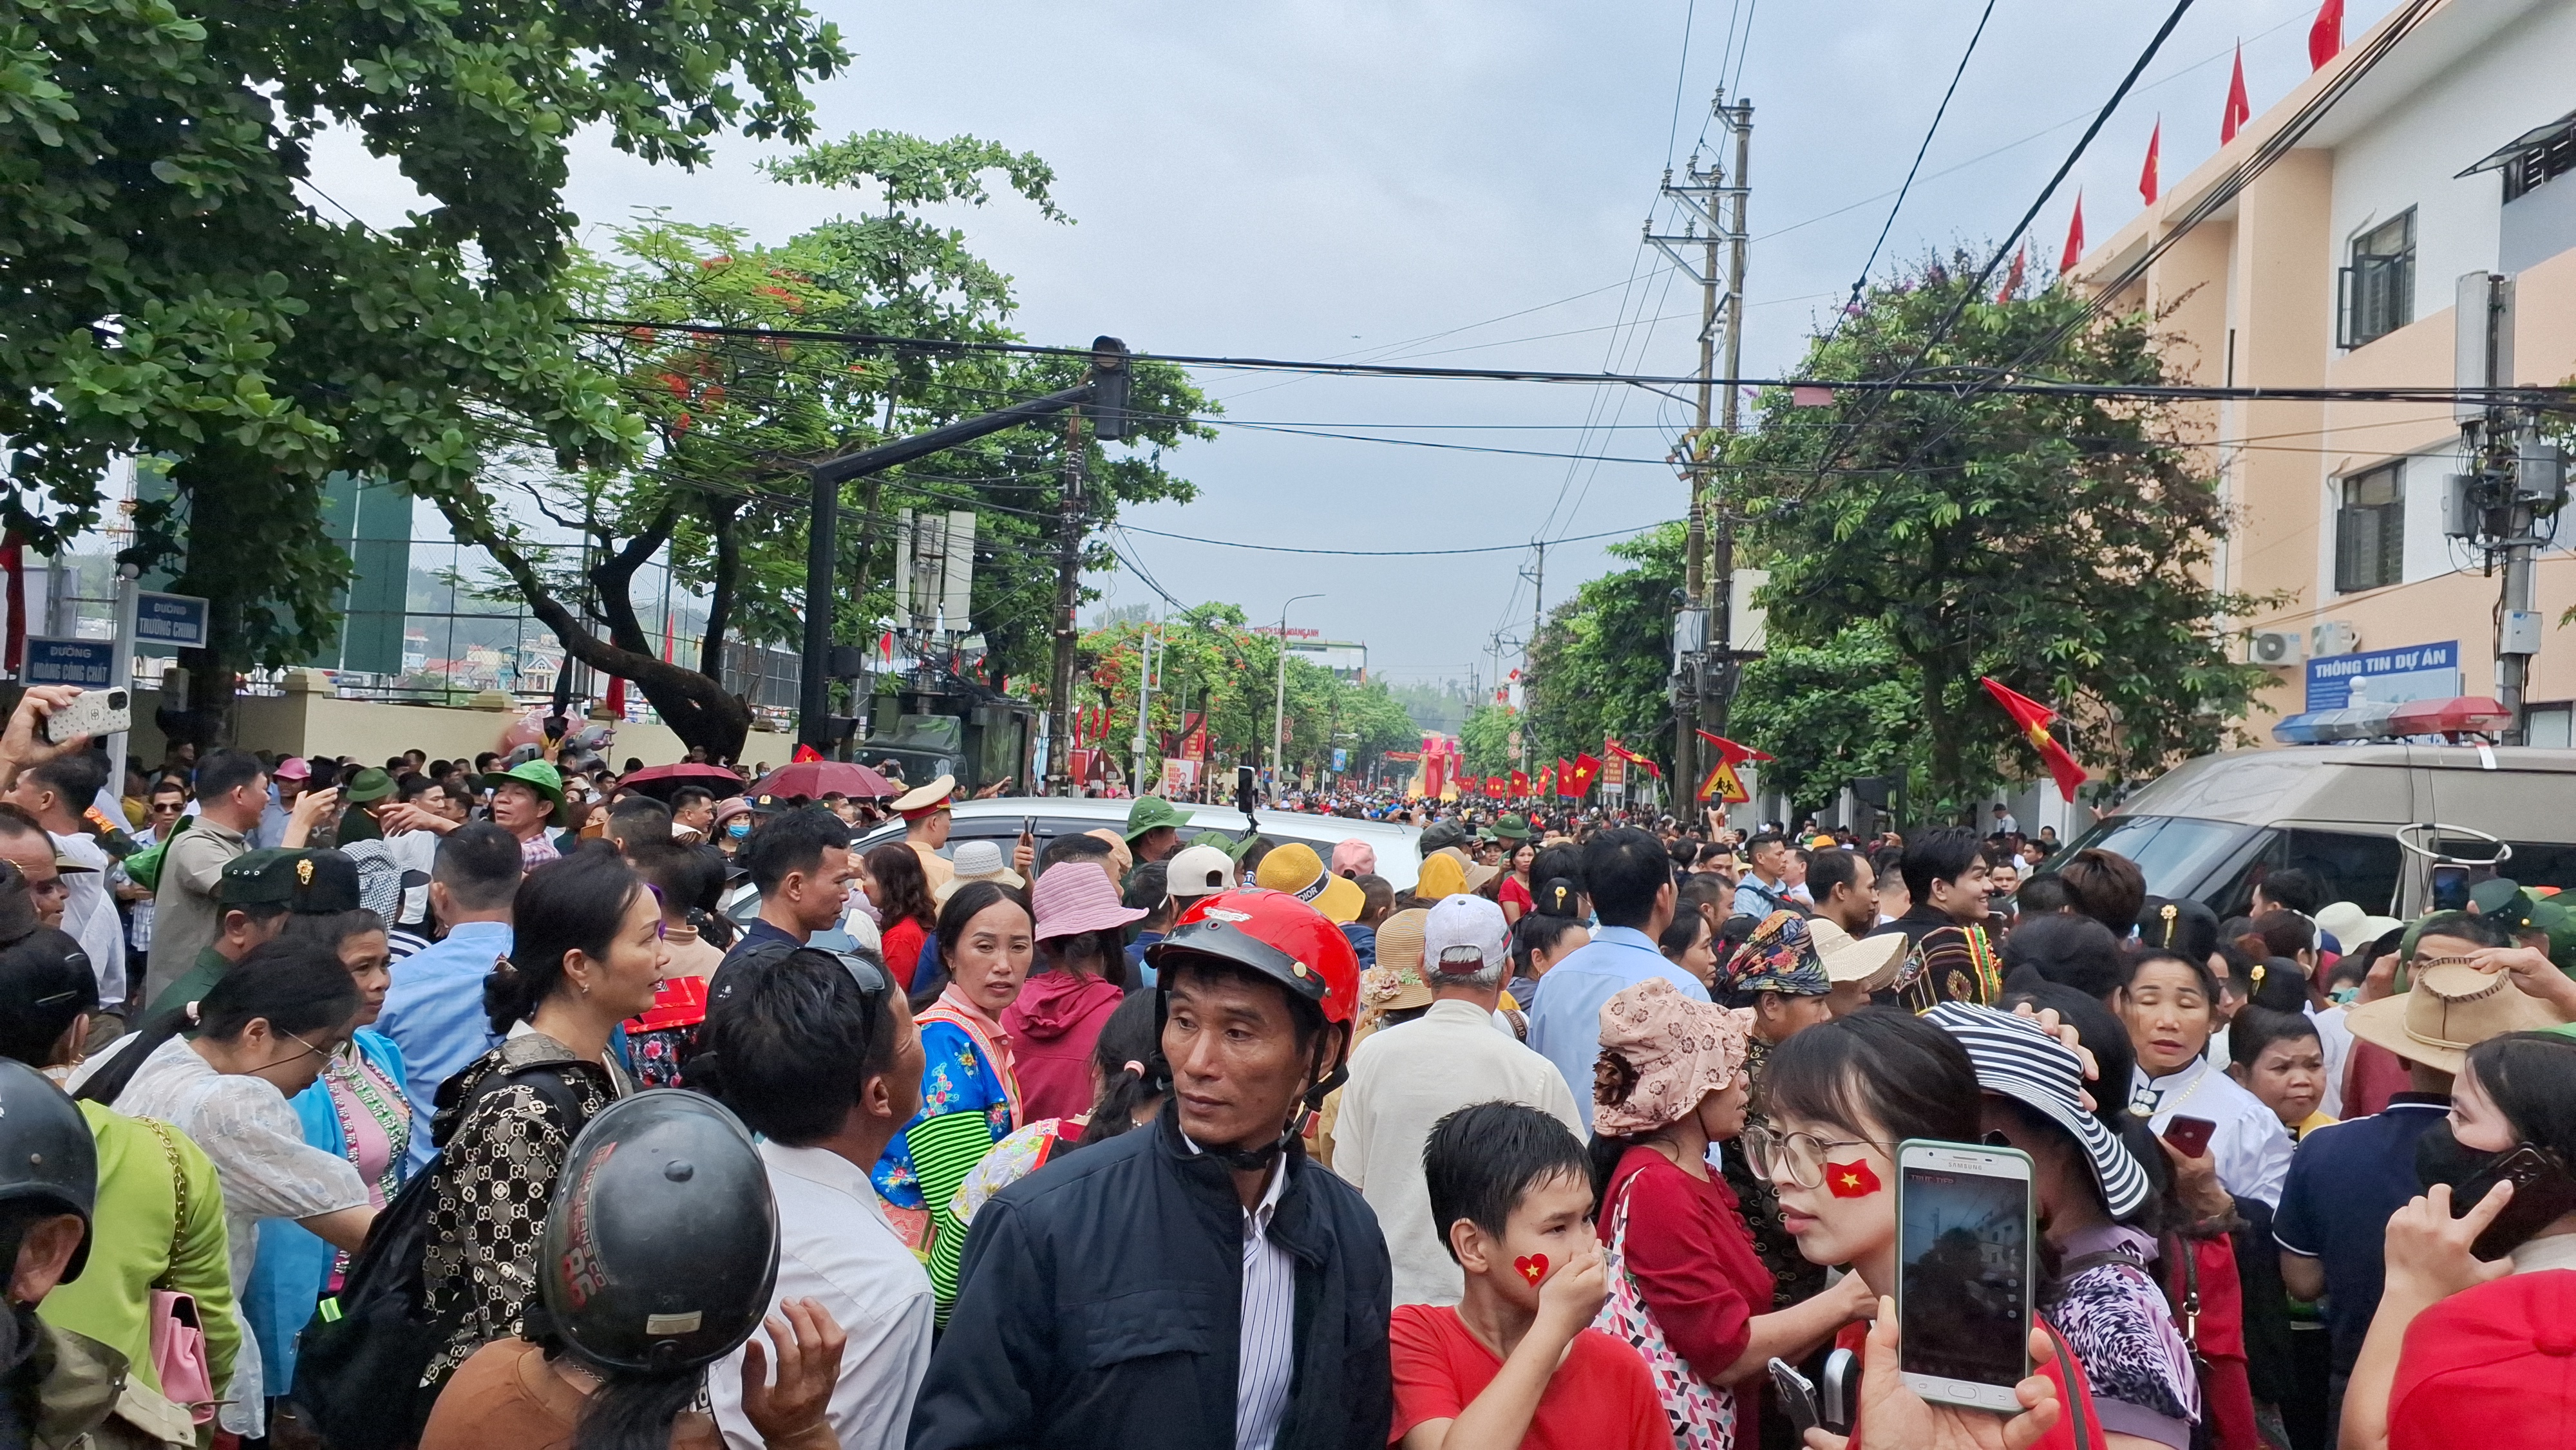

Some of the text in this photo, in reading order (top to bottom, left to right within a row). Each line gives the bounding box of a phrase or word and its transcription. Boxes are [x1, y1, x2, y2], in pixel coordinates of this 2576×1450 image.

[50, 645, 91, 658] ĐƯỜNG
[33, 660, 61, 679] HOÀNG
[62, 661, 84, 681] CÔNG
[2315, 648, 2446, 678] THÔNG TIN DỰ ÁN
[1298, 886, 1318, 901] DIOR
[1949, 1162, 1982, 1171] SAMSUNG
